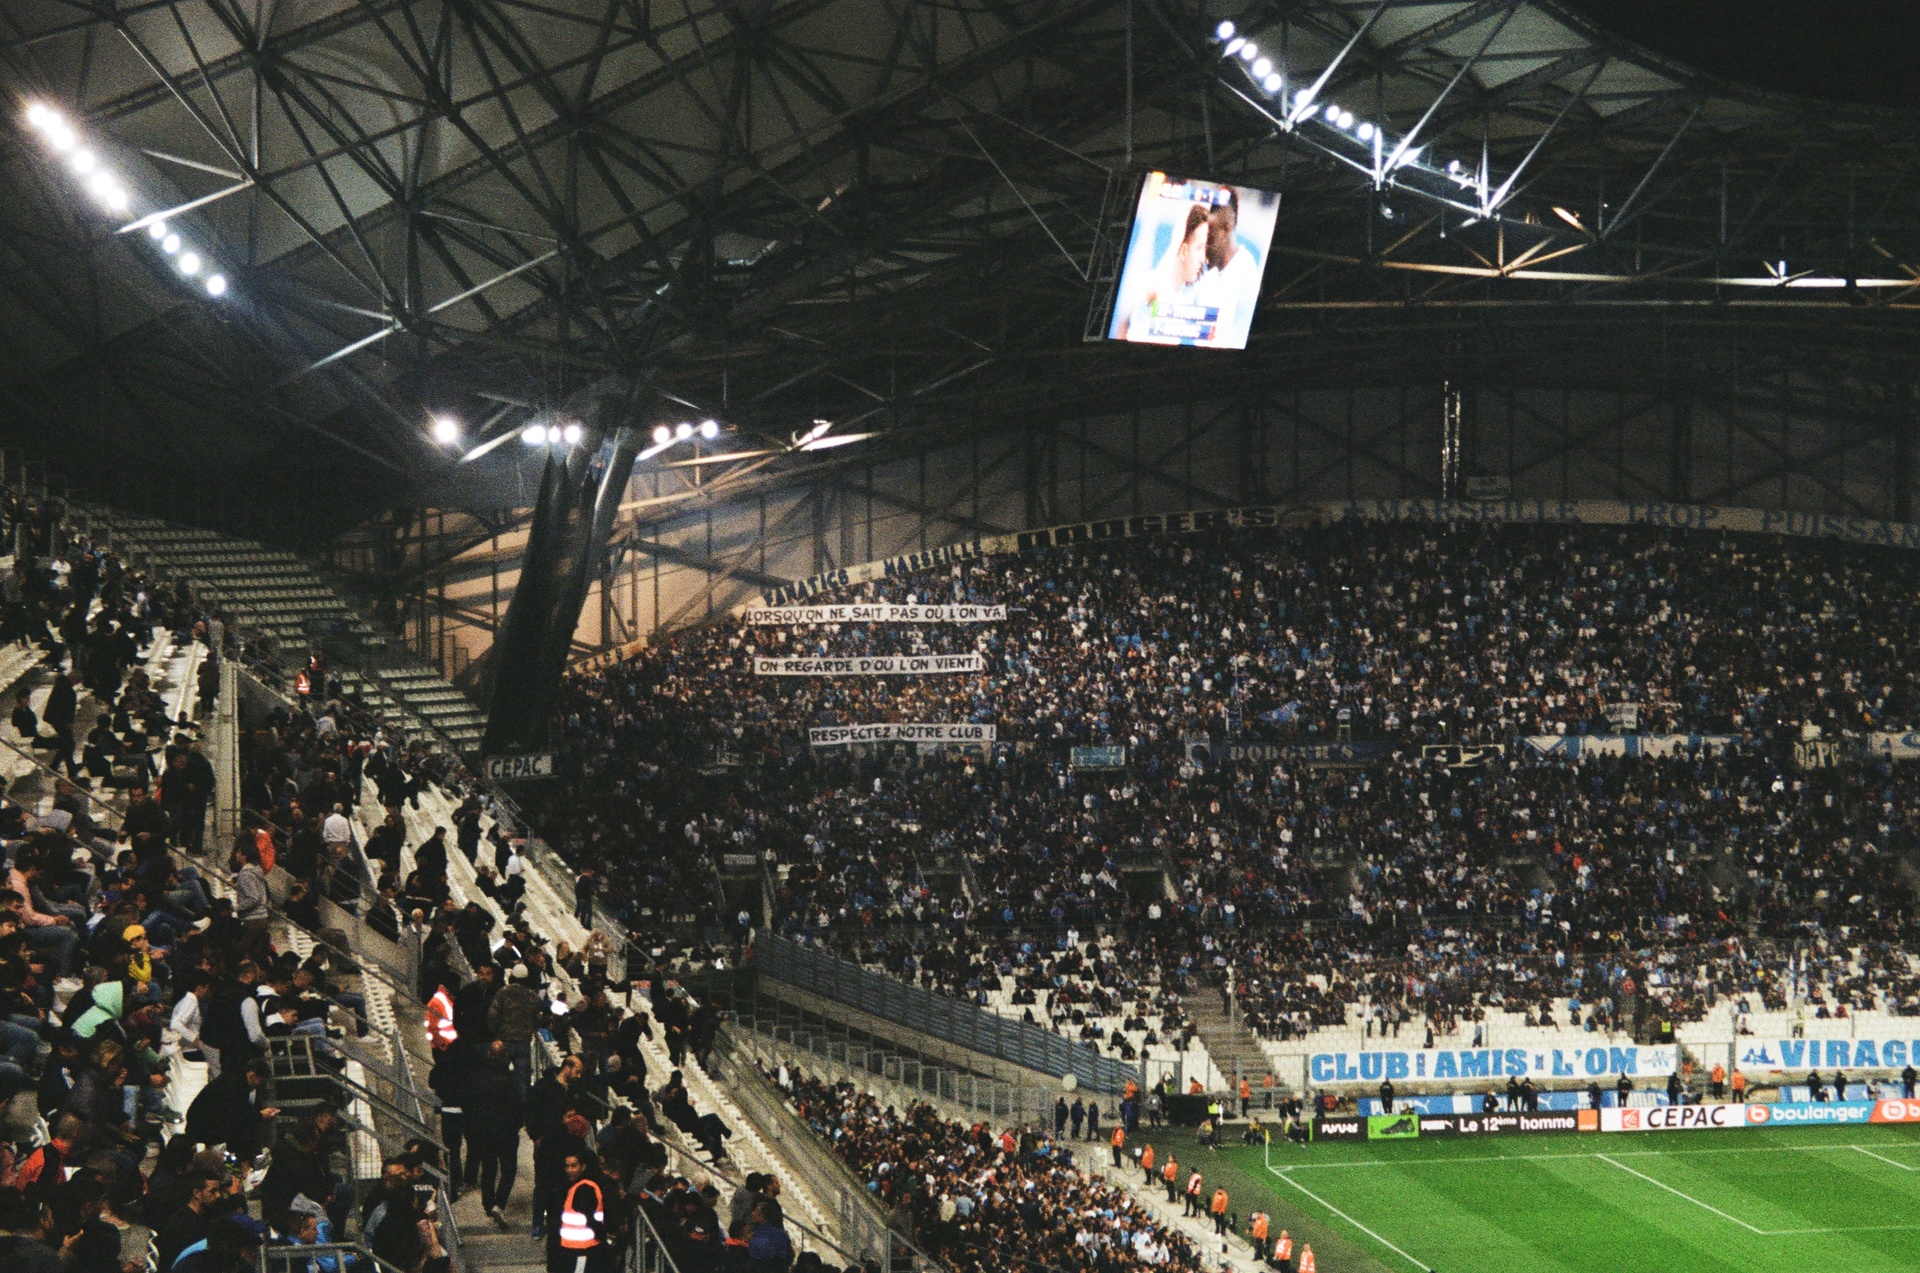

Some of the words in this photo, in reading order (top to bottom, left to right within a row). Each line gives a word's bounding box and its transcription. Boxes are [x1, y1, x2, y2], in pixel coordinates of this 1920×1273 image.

[1626, 500, 1718, 528] TROP
[882, 538, 981, 577] MARSEILLE
[747, 608, 823, 622] LORSQU'ON
[829, 607, 846, 619] NE
[852, 606, 882, 618] SAIT
[889, 607, 918, 619] PAS
[949, 607, 977, 619] L'ON
[760, 660, 778, 671] ON
[784, 660, 853, 672] REGARDE
[899, 659, 928, 671] L'ON
[810, 726, 891, 742] RESPECTEZ
[896, 726, 942, 738] NOTRE
[948, 727, 983, 739] CLUB
[491, 757, 542, 778] CEPAC
[1311, 1051, 1409, 1082] CLUB
[1433, 1048, 1528, 1078] AMIS
[1552, 1047, 1638, 1076] L'OM
[1647, 1105, 1726, 1128] CEPAC
[1772, 1105, 1867, 1122] boulanger
[1459, 1118, 1478, 1132] Le
[1519, 1116, 1576, 1130] homme
